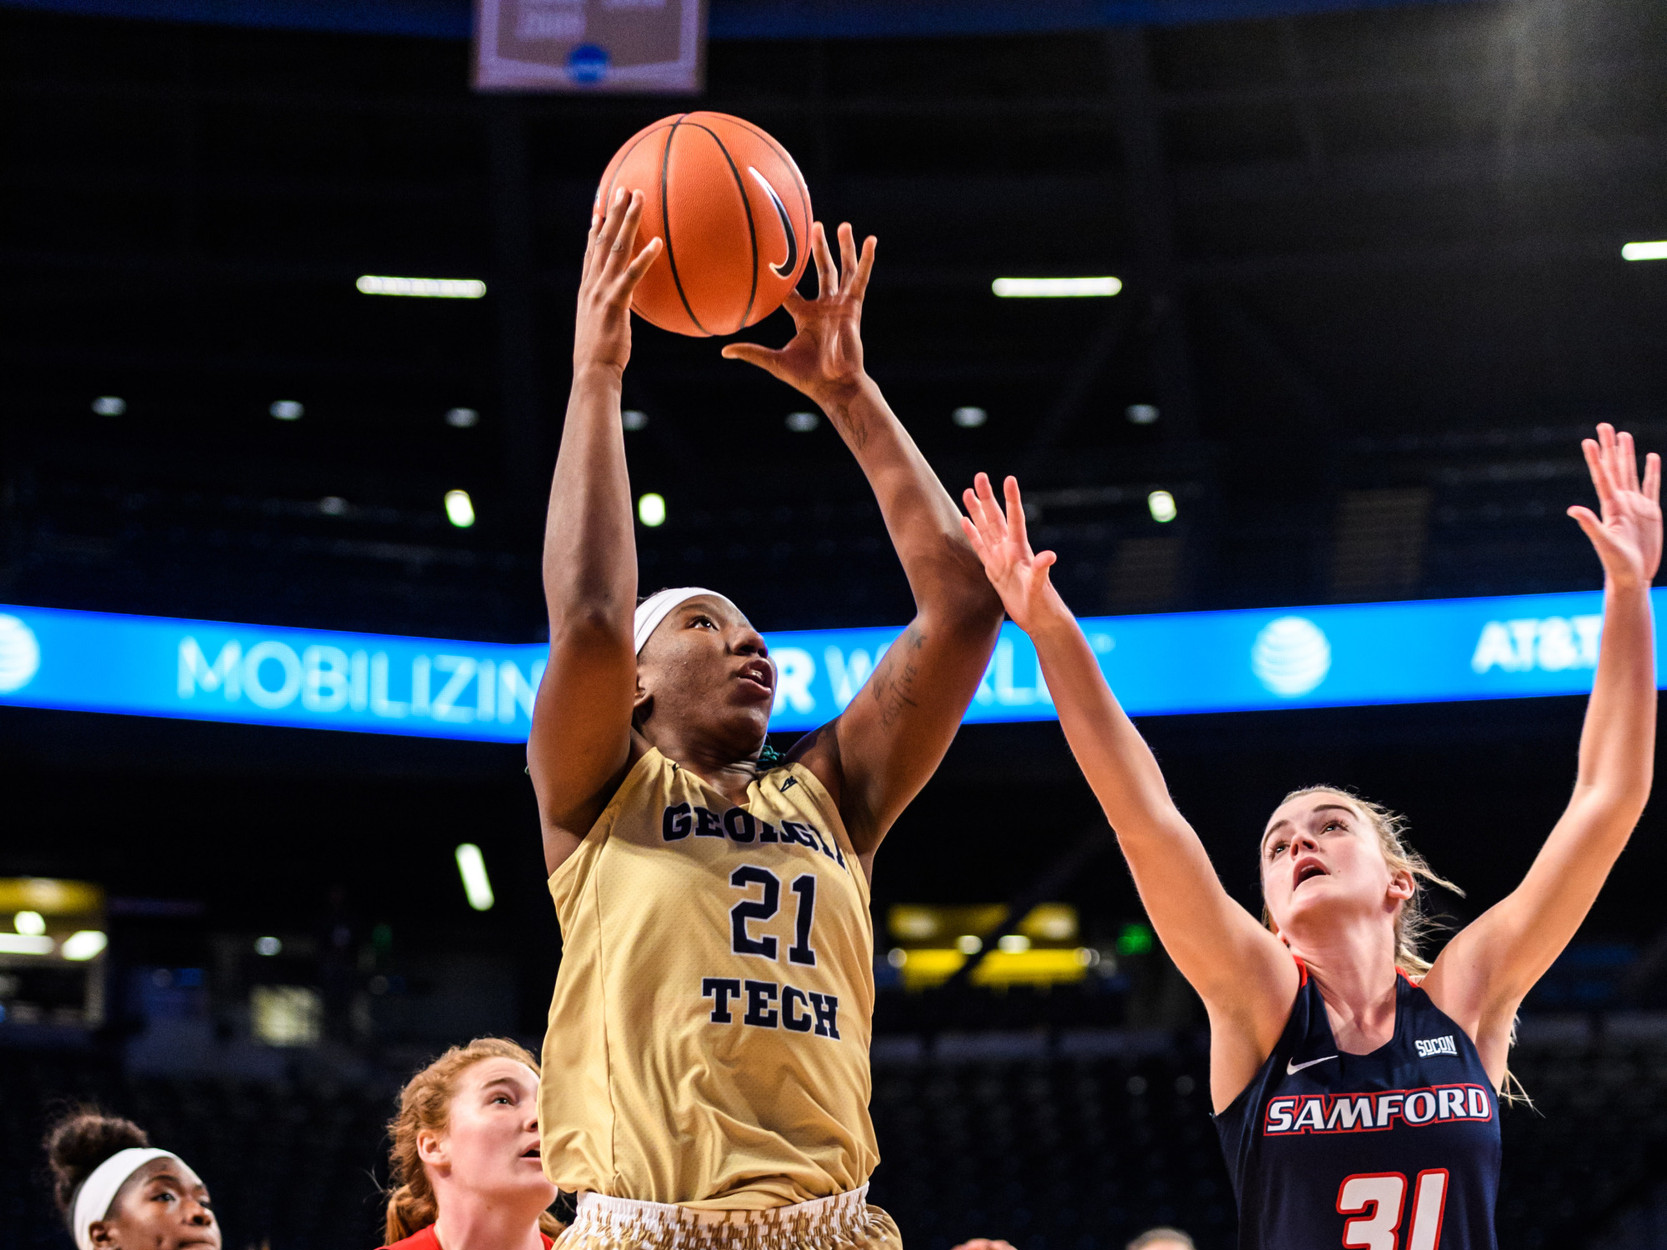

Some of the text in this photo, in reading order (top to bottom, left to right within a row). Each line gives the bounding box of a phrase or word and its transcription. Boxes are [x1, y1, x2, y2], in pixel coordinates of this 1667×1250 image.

[729, 863, 817, 967] 21
[702, 977, 841, 1040] TECH
[1415, 1035, 1457, 1057] SOCON
[1264, 1083, 1492, 1136] SAMFORD
